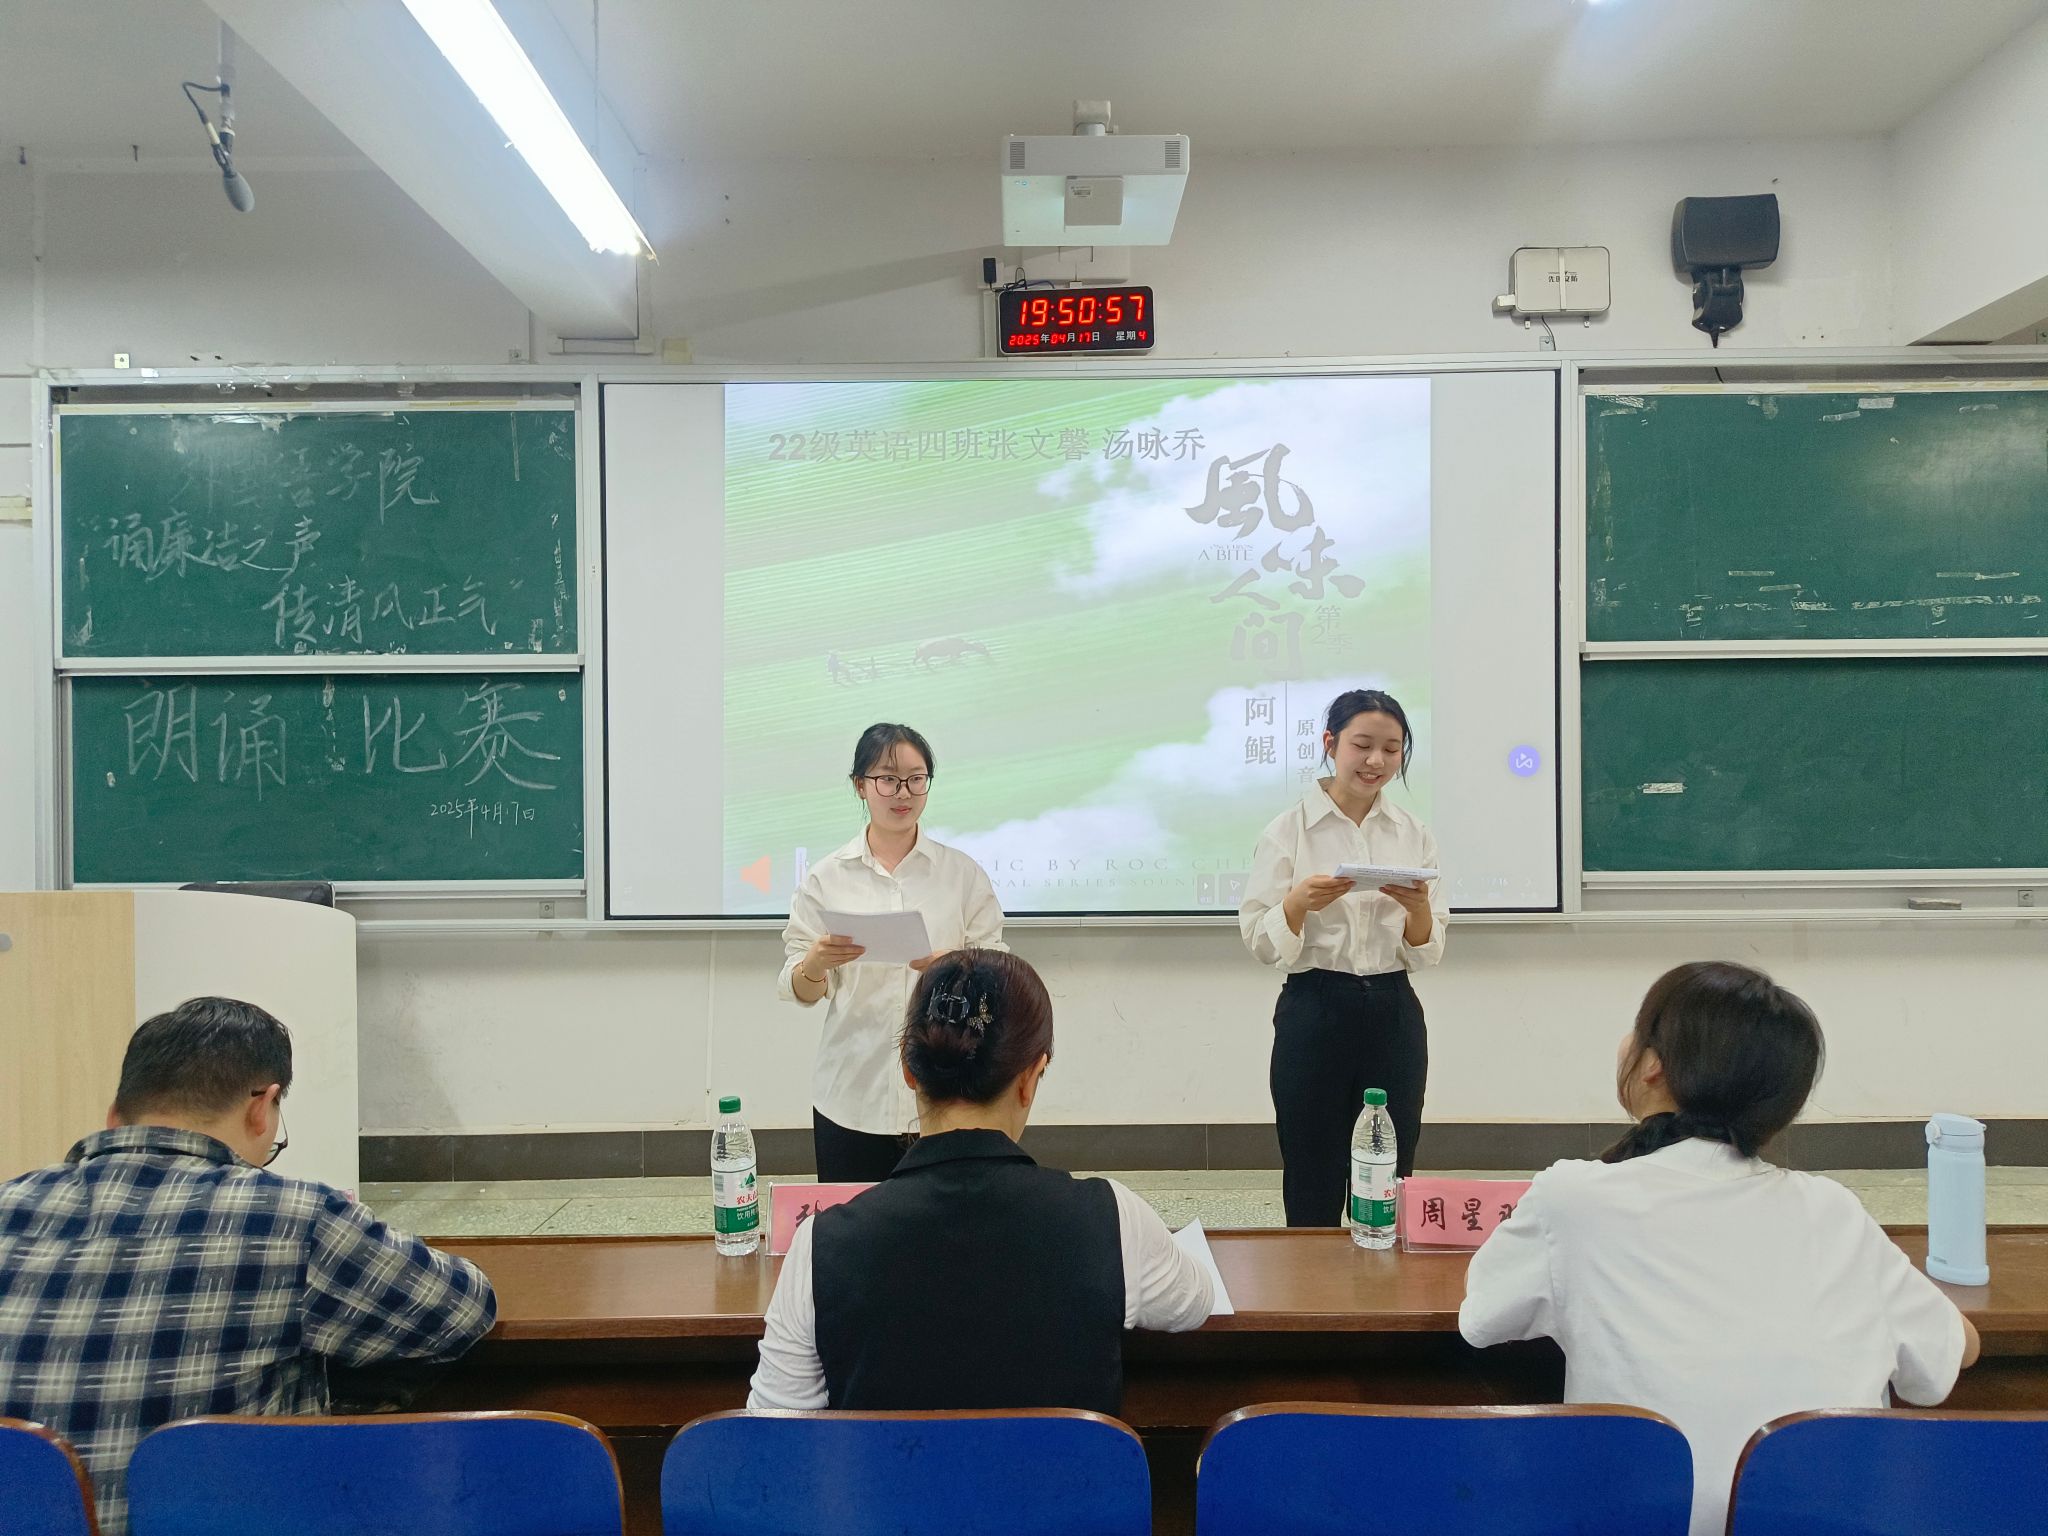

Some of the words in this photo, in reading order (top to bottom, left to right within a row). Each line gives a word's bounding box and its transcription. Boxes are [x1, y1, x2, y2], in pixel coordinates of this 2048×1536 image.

[1019, 295, 1145, 326] 19:50:57
[768, 427, 1090, 462] 22级英语四班张文馨
[1102, 426, 1206, 461] 汤咏乔
[1216, 549, 1254, 561] BITE
[123, 683, 561, 800] 朗诵比赛
[1245, 696, 1277, 765] 阿鲲
[1049, 859, 1080, 871] BY
[1106, 859, 1168, 871] ROC
[1044, 879, 1116, 888] SERIES
